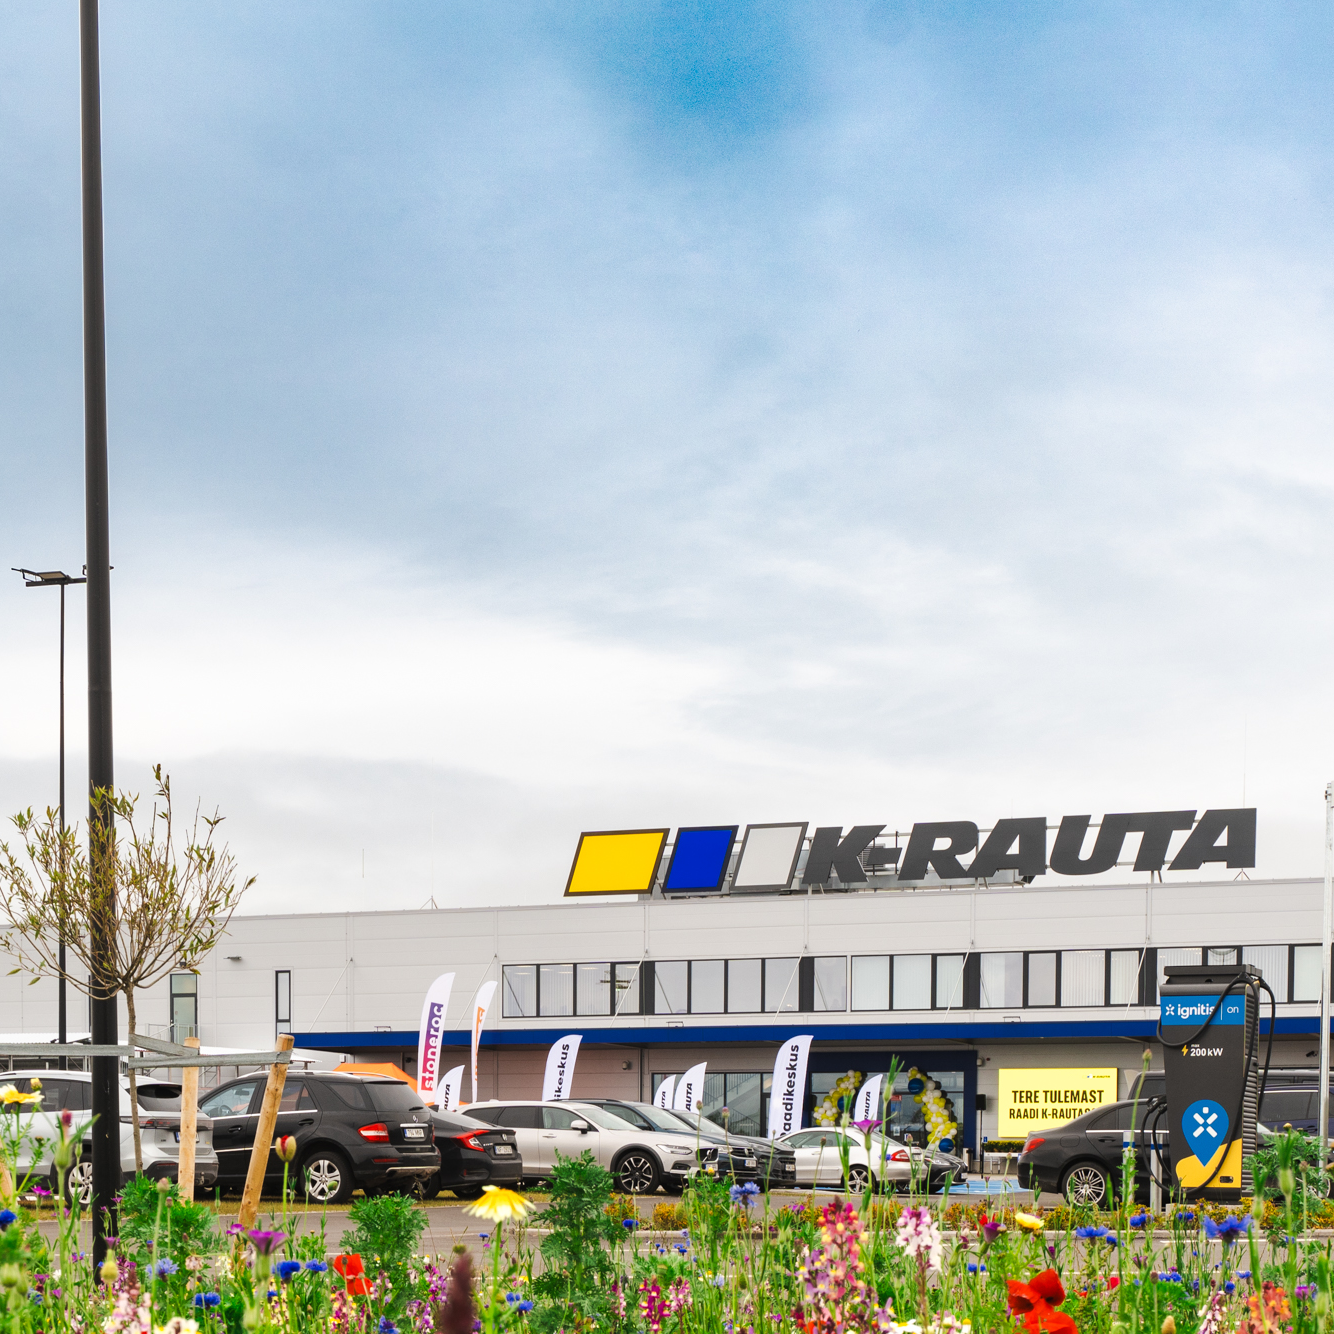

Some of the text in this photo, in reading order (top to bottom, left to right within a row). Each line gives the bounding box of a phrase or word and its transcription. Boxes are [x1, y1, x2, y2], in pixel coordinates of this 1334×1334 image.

[801, 808, 1257, 884] K-RAUTA
[1177, 1003, 1239, 1019] ignitis on
[424, 1004, 443, 1089] stoneroc
[1190, 1048, 1223, 1057] 200 kW
[553, 1043, 570, 1101] ikeskus
[1012, 1090, 1104, 1103] TERE TULEMAST
[1009, 1107, 1096, 1119] RAADI K-RAUTA
